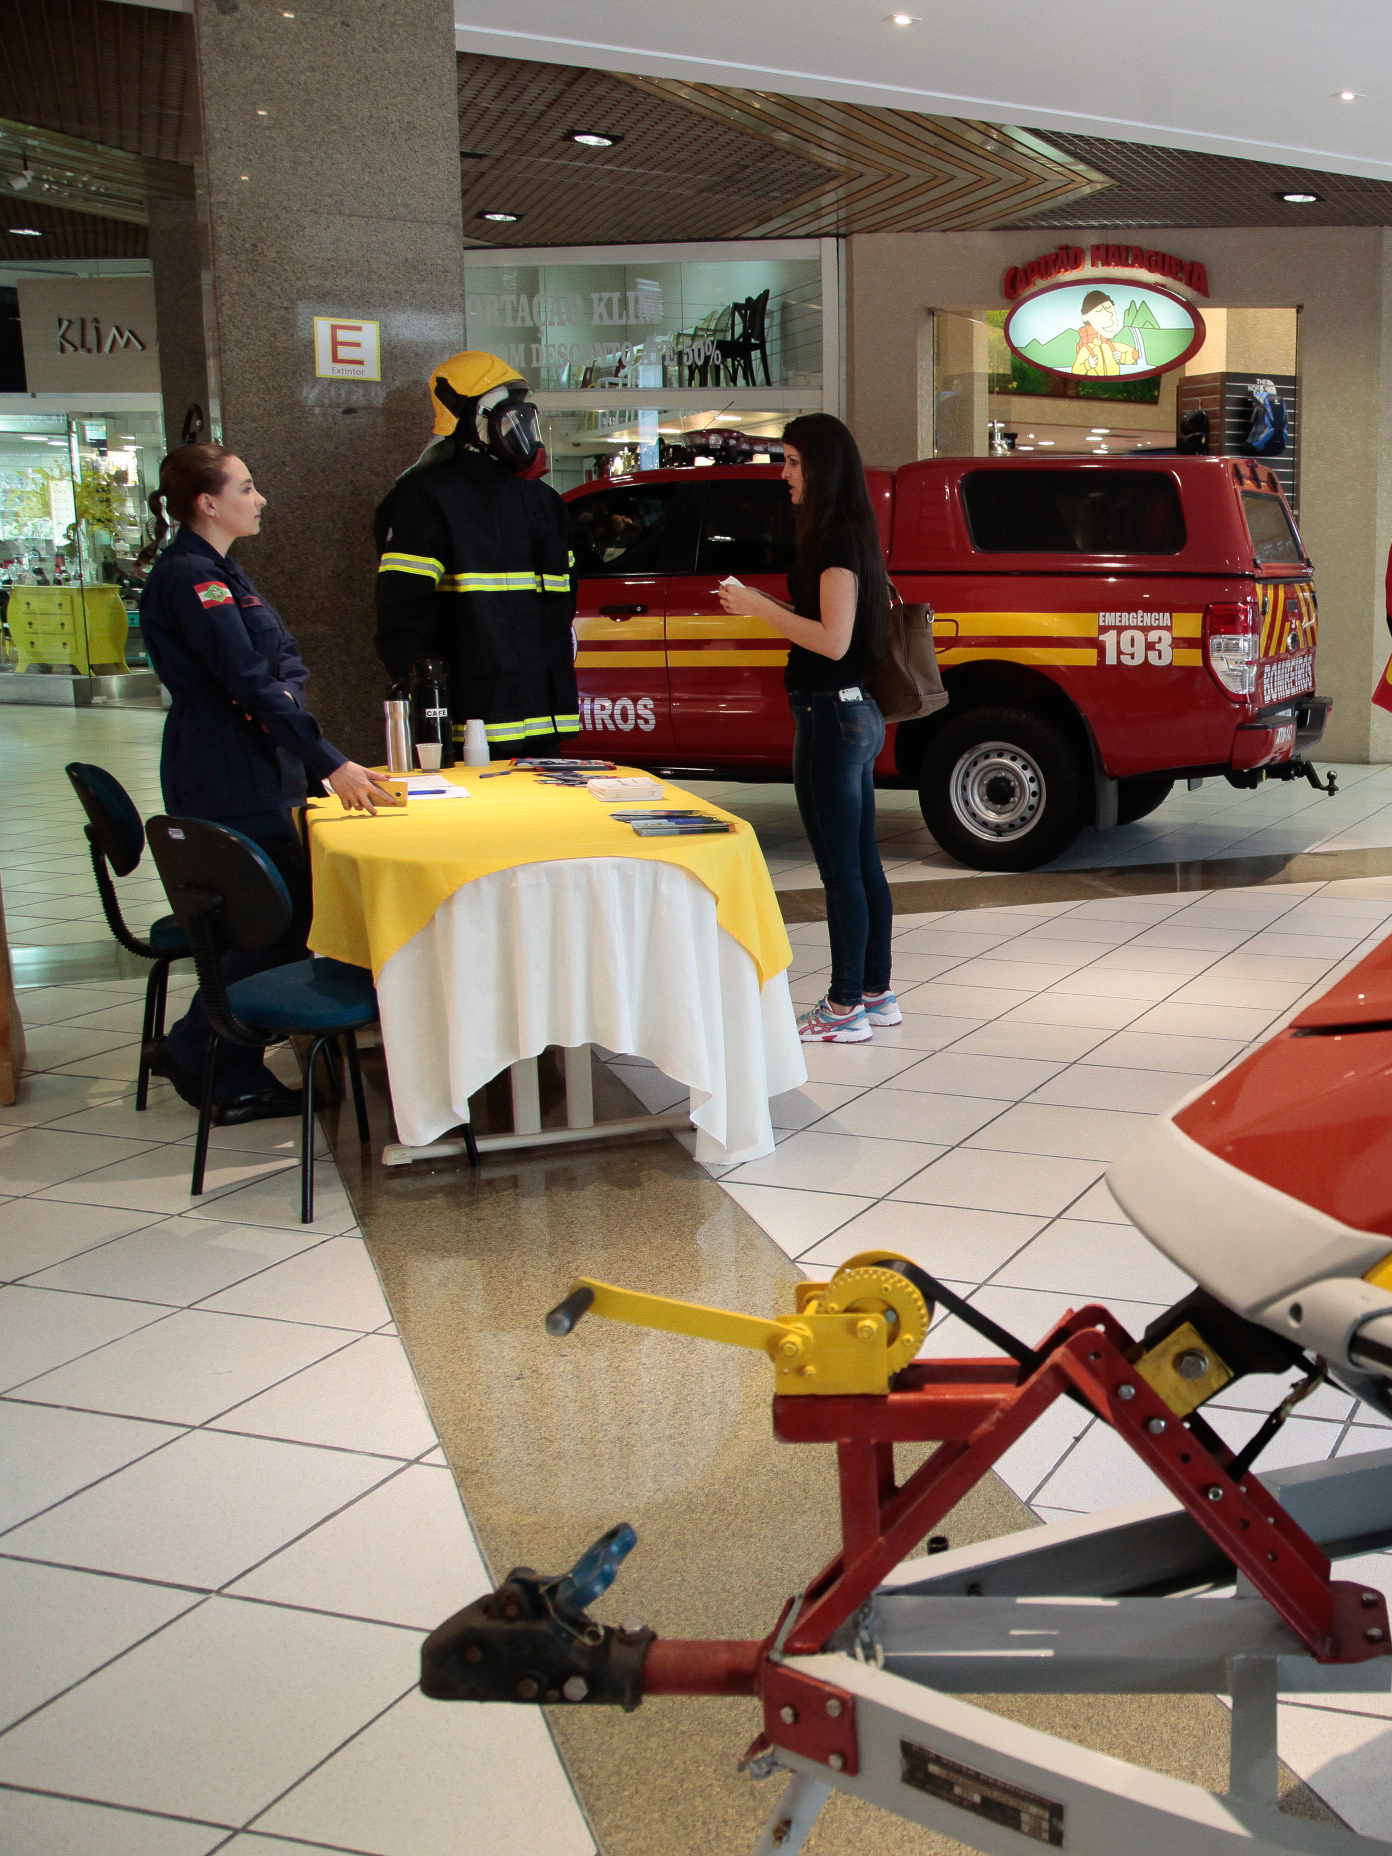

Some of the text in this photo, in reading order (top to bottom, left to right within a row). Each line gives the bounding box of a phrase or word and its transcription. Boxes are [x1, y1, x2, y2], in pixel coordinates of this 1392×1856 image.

[1004, 243, 1210, 300] CAPITÃO MALAGUETA
[331, 324, 364, 366] E
[683, 339, 722, 367] 50%
[332, 366, 365, 376] Extintor
[1098, 610, 1172, 627] EMERGÊNCIA
[1098, 629, 1173, 666] 193
[426, 709, 447, 717] CAFÉ
